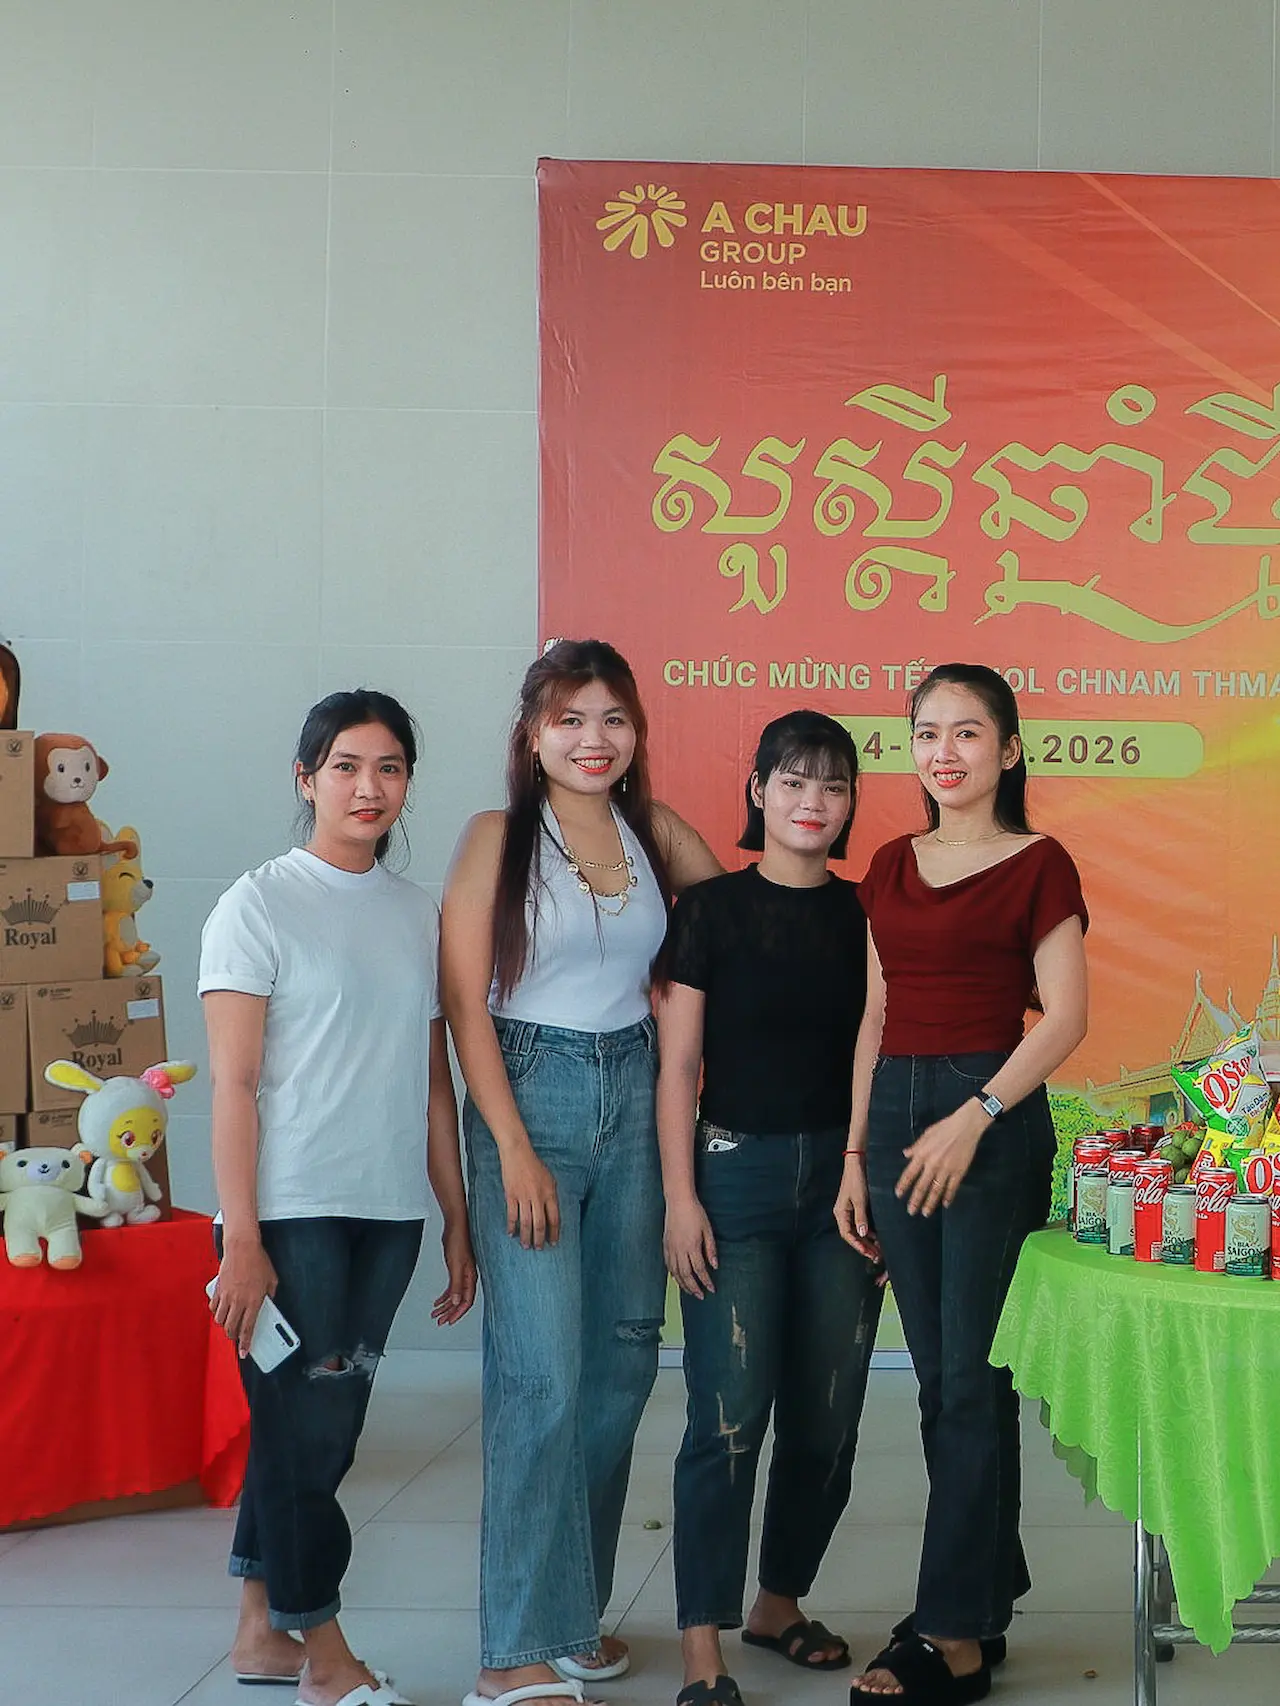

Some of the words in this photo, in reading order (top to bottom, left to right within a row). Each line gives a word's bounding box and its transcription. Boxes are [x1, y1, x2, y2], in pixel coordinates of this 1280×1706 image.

[701, 201, 735, 233] A
[744, 202, 868, 237] CHAU
[700, 241, 806, 264] GROUP
[700, 271, 755, 289] Luôn
[762, 272, 803, 291] bên
[811, 273, 851, 296] bạn
[663, 654, 757, 688] CHÚC
[769, 657, 871, 690] MỪNG
[993, 666, 1045, 694] OL
[1056, 668, 1181, 696] CHNAM
[5, 928, 57, 950] Royal
[72, 1048, 122, 1071] Royal
[1227, 1246, 1262, 1258] SAIGON
